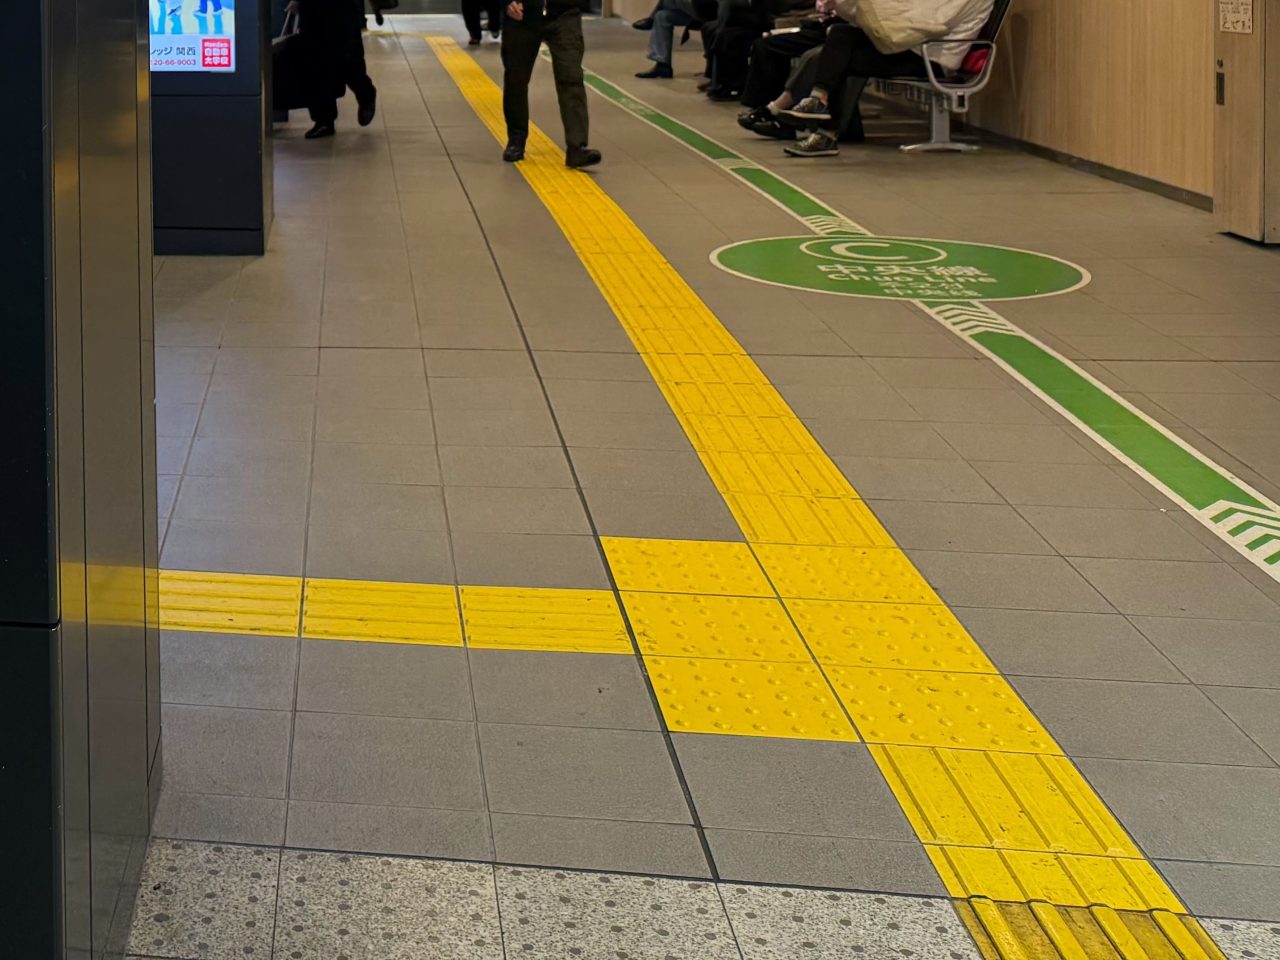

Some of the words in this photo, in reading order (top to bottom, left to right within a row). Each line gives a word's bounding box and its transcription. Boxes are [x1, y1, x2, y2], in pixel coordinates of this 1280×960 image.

[817, 264, 989, 276] 中央線
[827, 274, 915, 282] Chuo
[924, 276, 998, 284] Line
